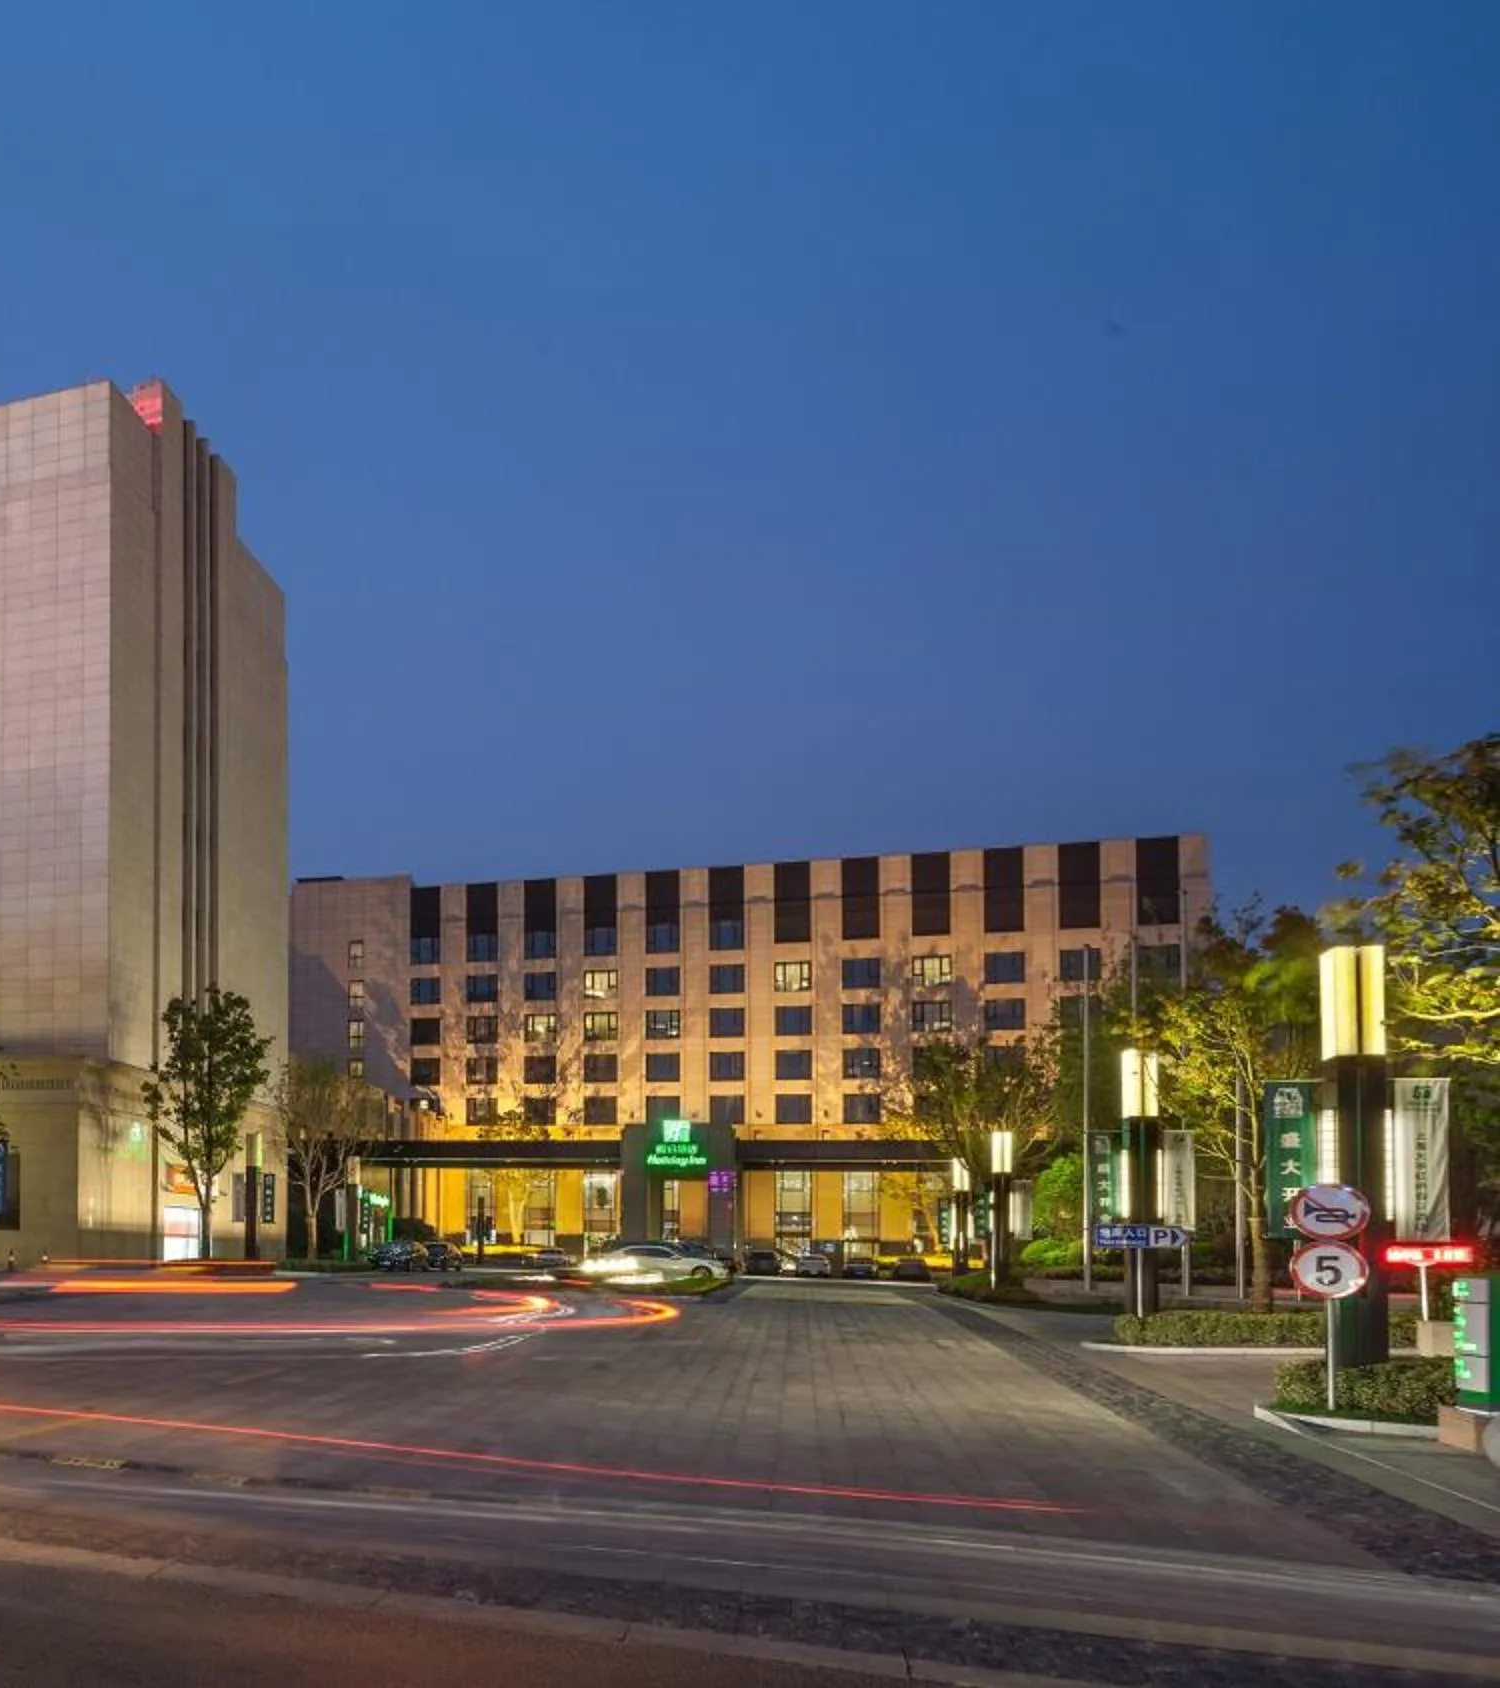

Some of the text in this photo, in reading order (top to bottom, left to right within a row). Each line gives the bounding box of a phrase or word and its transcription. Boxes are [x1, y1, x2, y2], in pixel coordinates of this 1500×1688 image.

[647, 1153, 688, 1167] Holiday
[1153, 1229, 1169, 1245] P
[1315, 1255, 1342, 1287] 5
